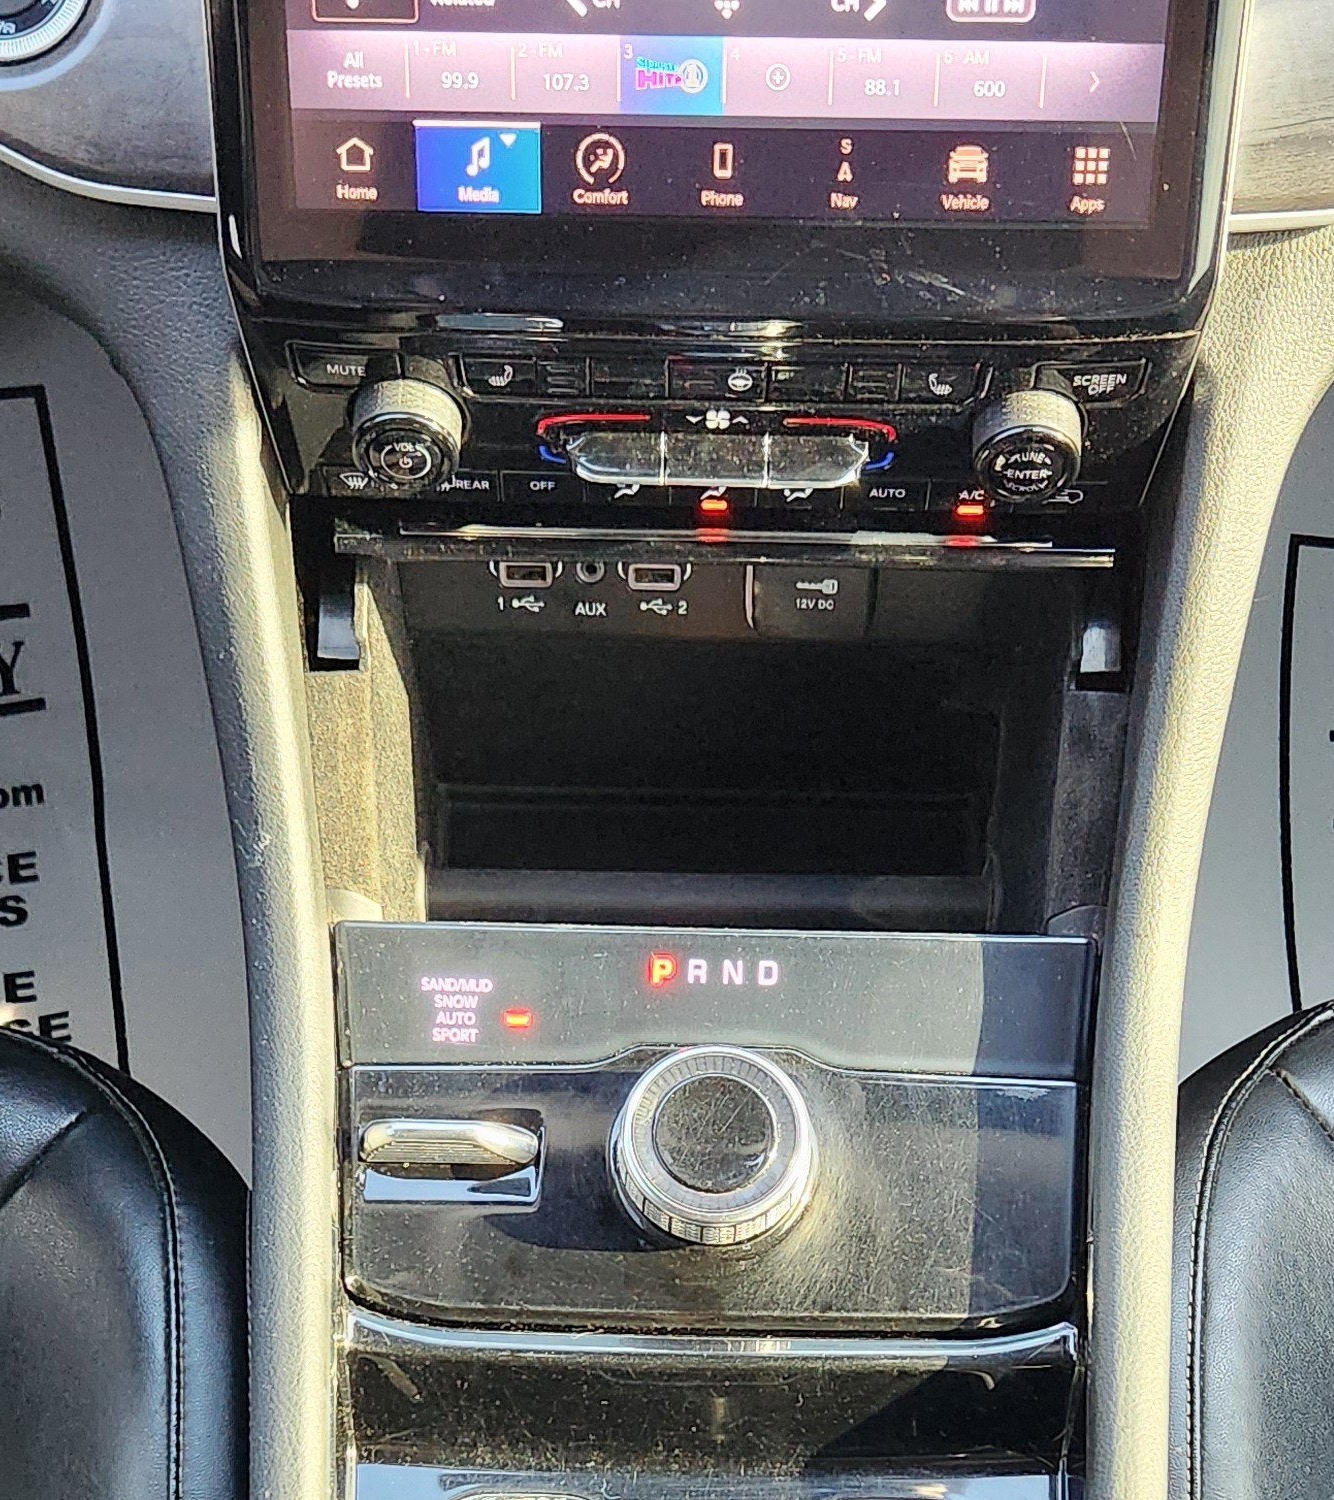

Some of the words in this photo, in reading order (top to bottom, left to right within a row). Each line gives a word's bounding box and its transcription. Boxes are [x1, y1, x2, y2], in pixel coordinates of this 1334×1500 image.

[432, 40, 458, 58] FM
[539, 42, 564, 59] FM
[624, 43, 634, 60] 3
[857, 48, 882, 64] FM
[343, 51, 365, 69] All
[963, 50, 990, 66] AM
[327, 70, 383, 89] Presets
[441, 71, 480, 90] 99.9
[543, 73, 590, 92] 107.3
[864, 78, 901, 97] 88.1
[973, 80, 1007, 98] 600
[336, 184, 378, 201] Home
[457, 186, 500, 204] Media
[572, 188, 629, 206] Comfort
[700, 189, 744, 207] Phone
[830, 191, 860, 209] Nav
[940, 193, 990, 211] Vehicle
[1069, 196, 1106, 214] Apps
[326, 363, 366, 378] MUTE
[1072, 373, 1127, 388] SCREEN
[1088, 384, 1115, 396] OFF
[1015, 451, 1047, 464] TUNE
[1006, 468, 1048, 480] ENTER
[455, 479, 490, 491] REAR
[529, 479, 556, 492] OFF
[868, 486, 906, 499] AUTO
[958, 488, 985, 501] A/C
[497, 596, 505, 611] 1
[574, 601, 608, 617] AUX
[678, 600, 689, 616] 2
[795, 598, 816, 610] 12V
[817, 599, 835, 611] DC
[650, 953, 677, 985] P
[687, 959, 707, 984] R
[722, 960, 744, 985] N
[757, 960, 779, 986] D
[420, 977, 494, 993] SAND/MUD
[433, 994, 479, 1009] SNOW
[435, 1011, 476, 1026] AUTO
[432, 1027, 479, 1043] SPORT
